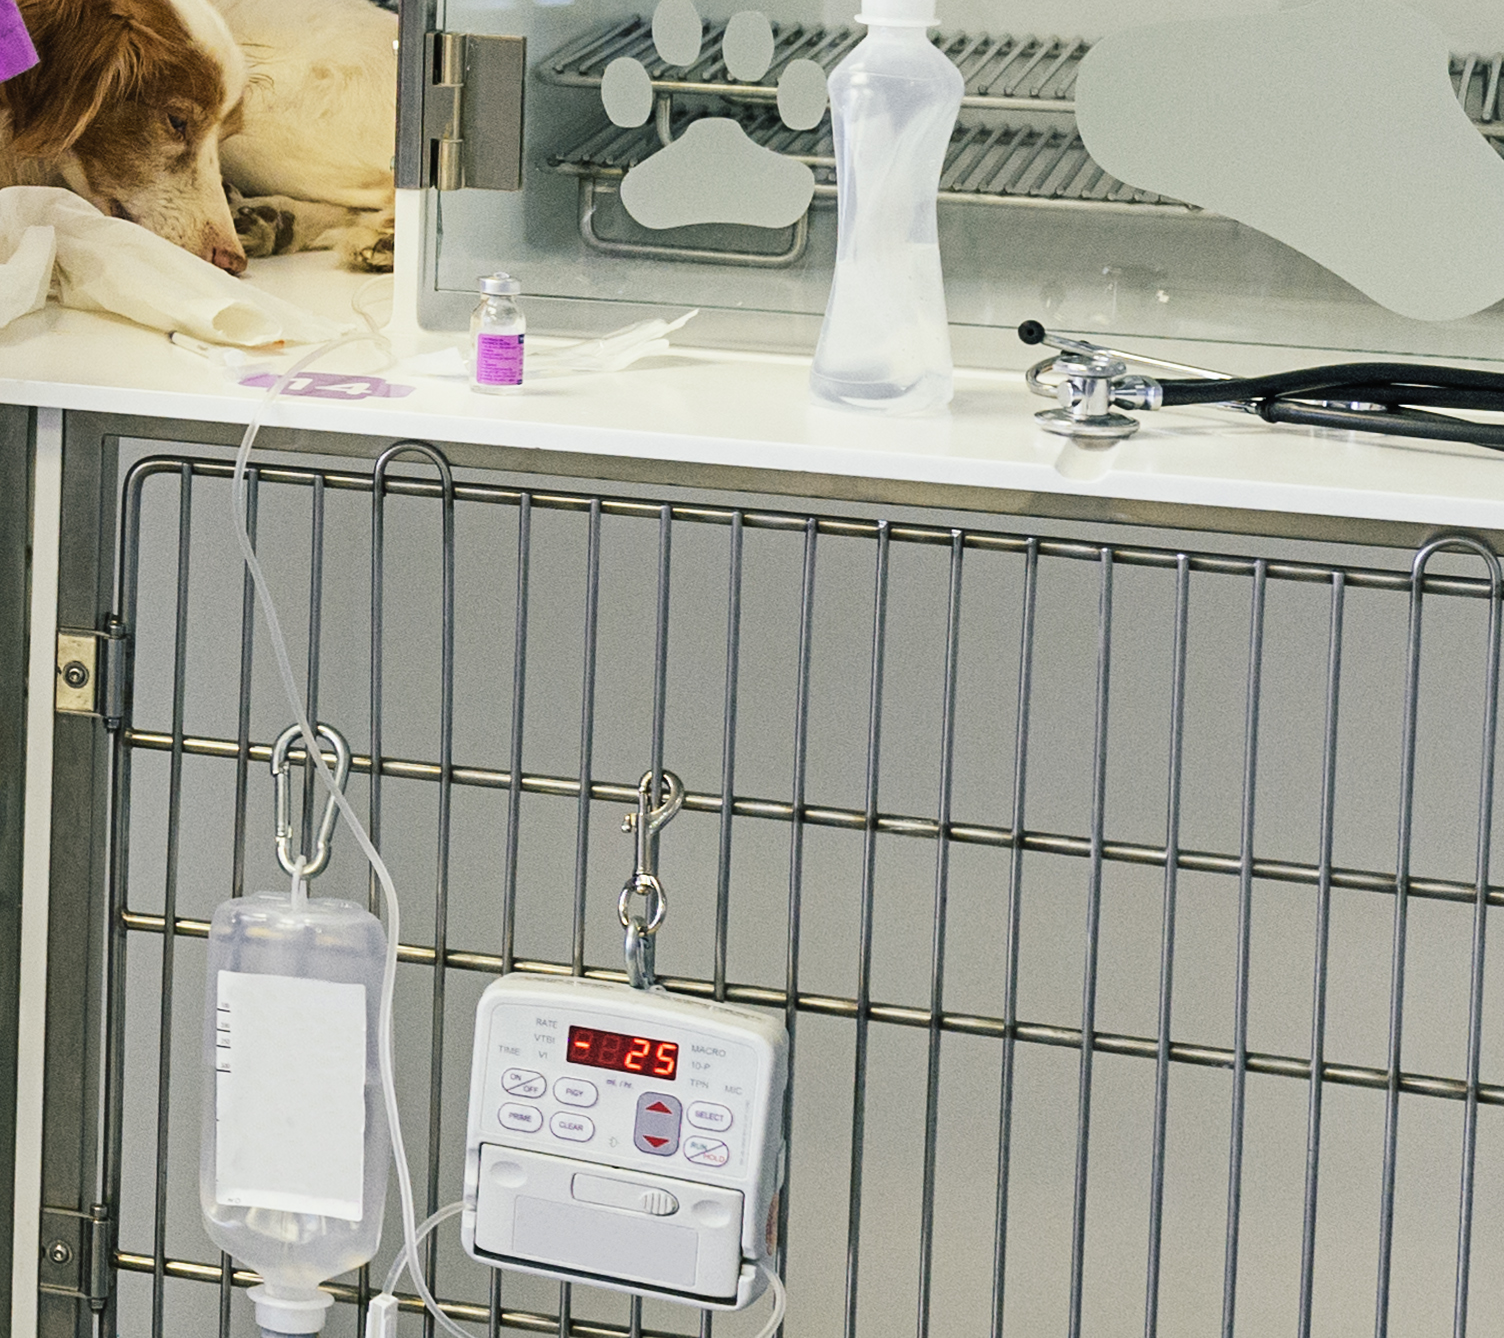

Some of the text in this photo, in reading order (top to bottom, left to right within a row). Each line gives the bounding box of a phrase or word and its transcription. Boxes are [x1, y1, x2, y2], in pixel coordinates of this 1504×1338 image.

[287, 377, 373, 395] 14
[536, 1018, 558, 1029] RATE
[499, 1045, 520, 1056] TIME
[624, 1037, 678, 1075] 25
[691, 1045, 726, 1057] MACRO
[510, 1073, 522, 1081] ON
[523, 1085, 538, 1093] OFF
[690, 1078, 709, 1089] TPN
[508, 1112, 532, 1123] PRIME
[695, 1110, 724, 1122] SELECT
[559, 1121, 584, 1131] CLEAR
[690, 1141, 708, 1151] RUN
[703, 1152, 725, 1163] HOLD
